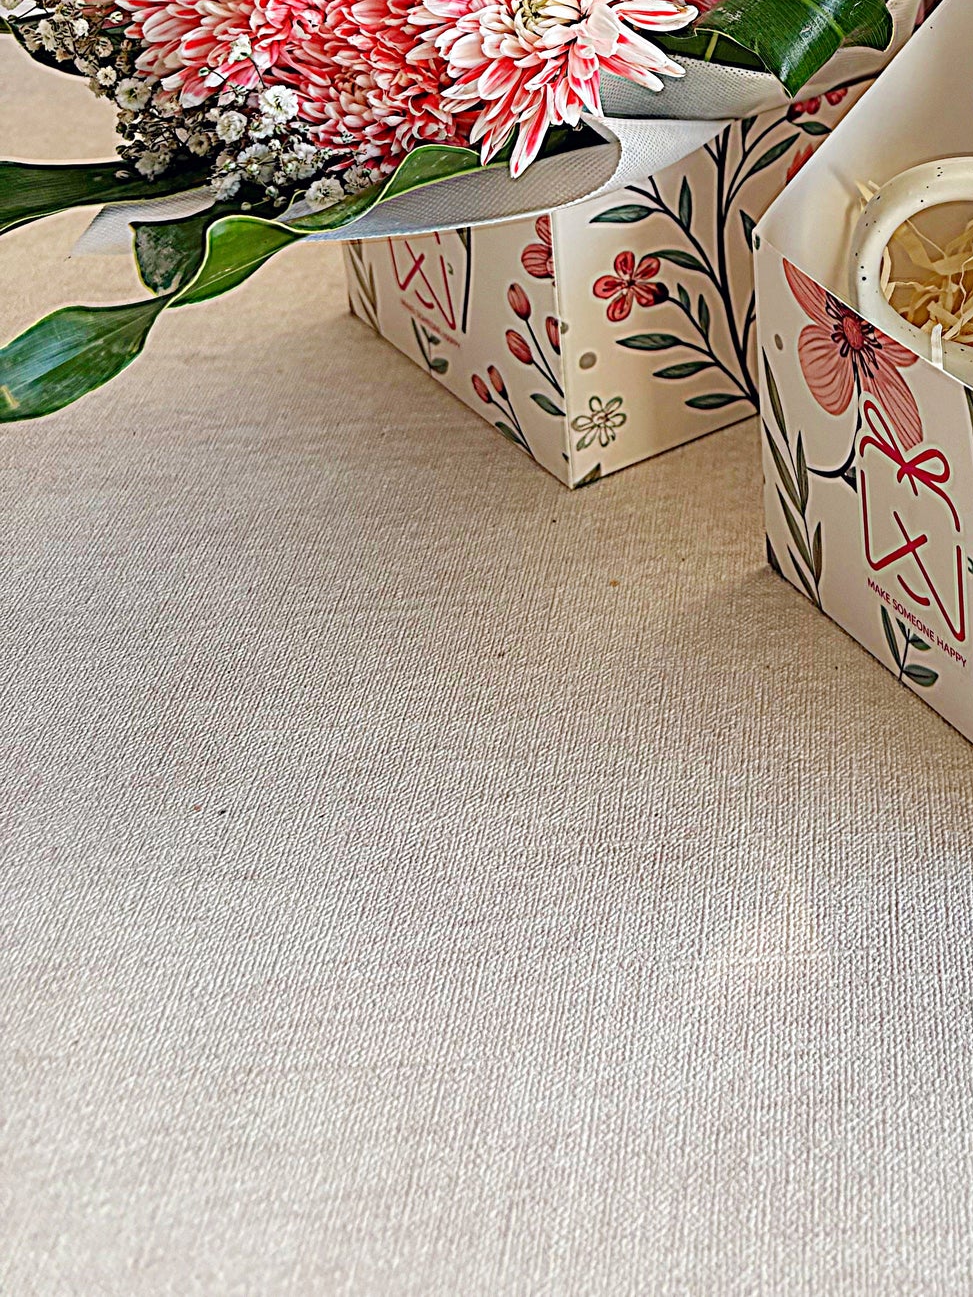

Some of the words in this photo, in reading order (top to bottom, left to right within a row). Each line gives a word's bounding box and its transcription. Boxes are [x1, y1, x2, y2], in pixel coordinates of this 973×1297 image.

[867, 577, 891, 604] MAKE
[892, 599, 935, 642] SOMEONE
[936, 636, 967, 667] HAPPY
